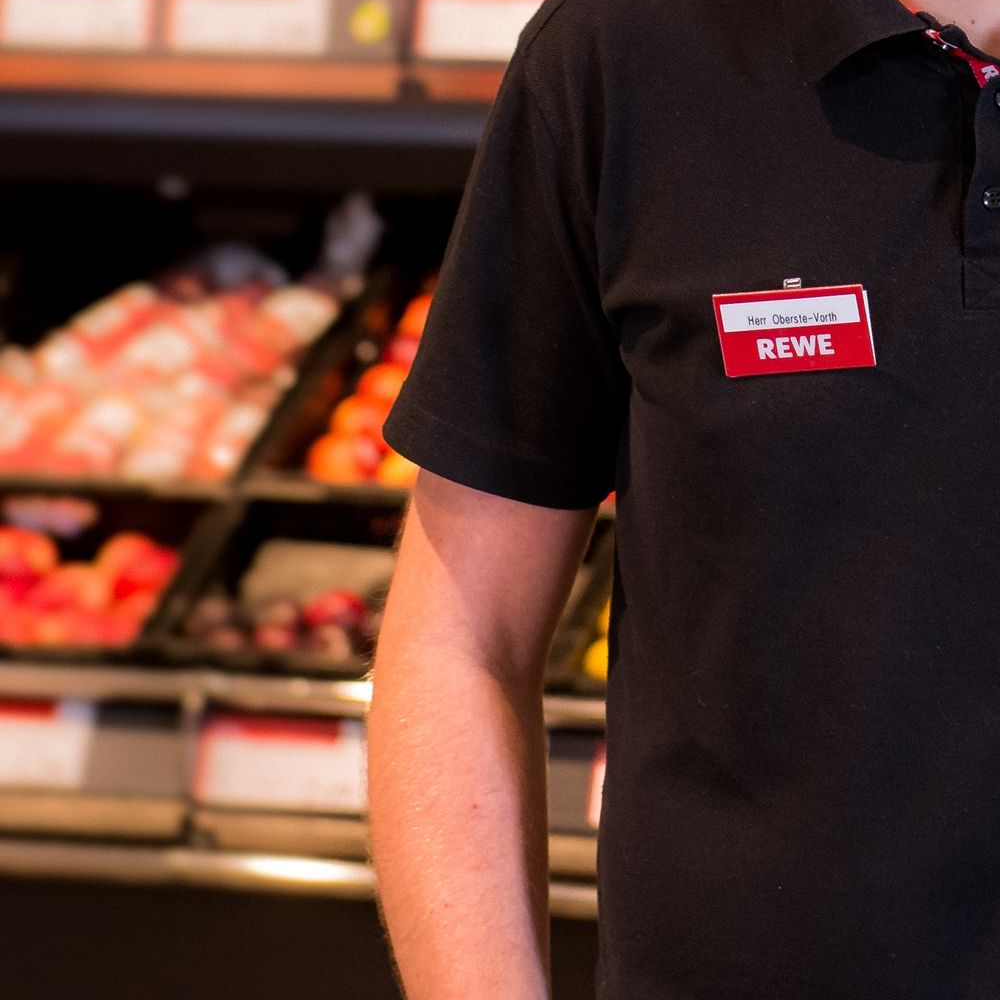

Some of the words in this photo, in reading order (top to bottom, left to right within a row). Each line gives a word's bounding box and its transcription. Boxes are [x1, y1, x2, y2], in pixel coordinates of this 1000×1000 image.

[748, 315, 767, 326] Herr
[772, 312, 838, 325] Oberste-Vorth
[756, 333, 835, 360] REWE
